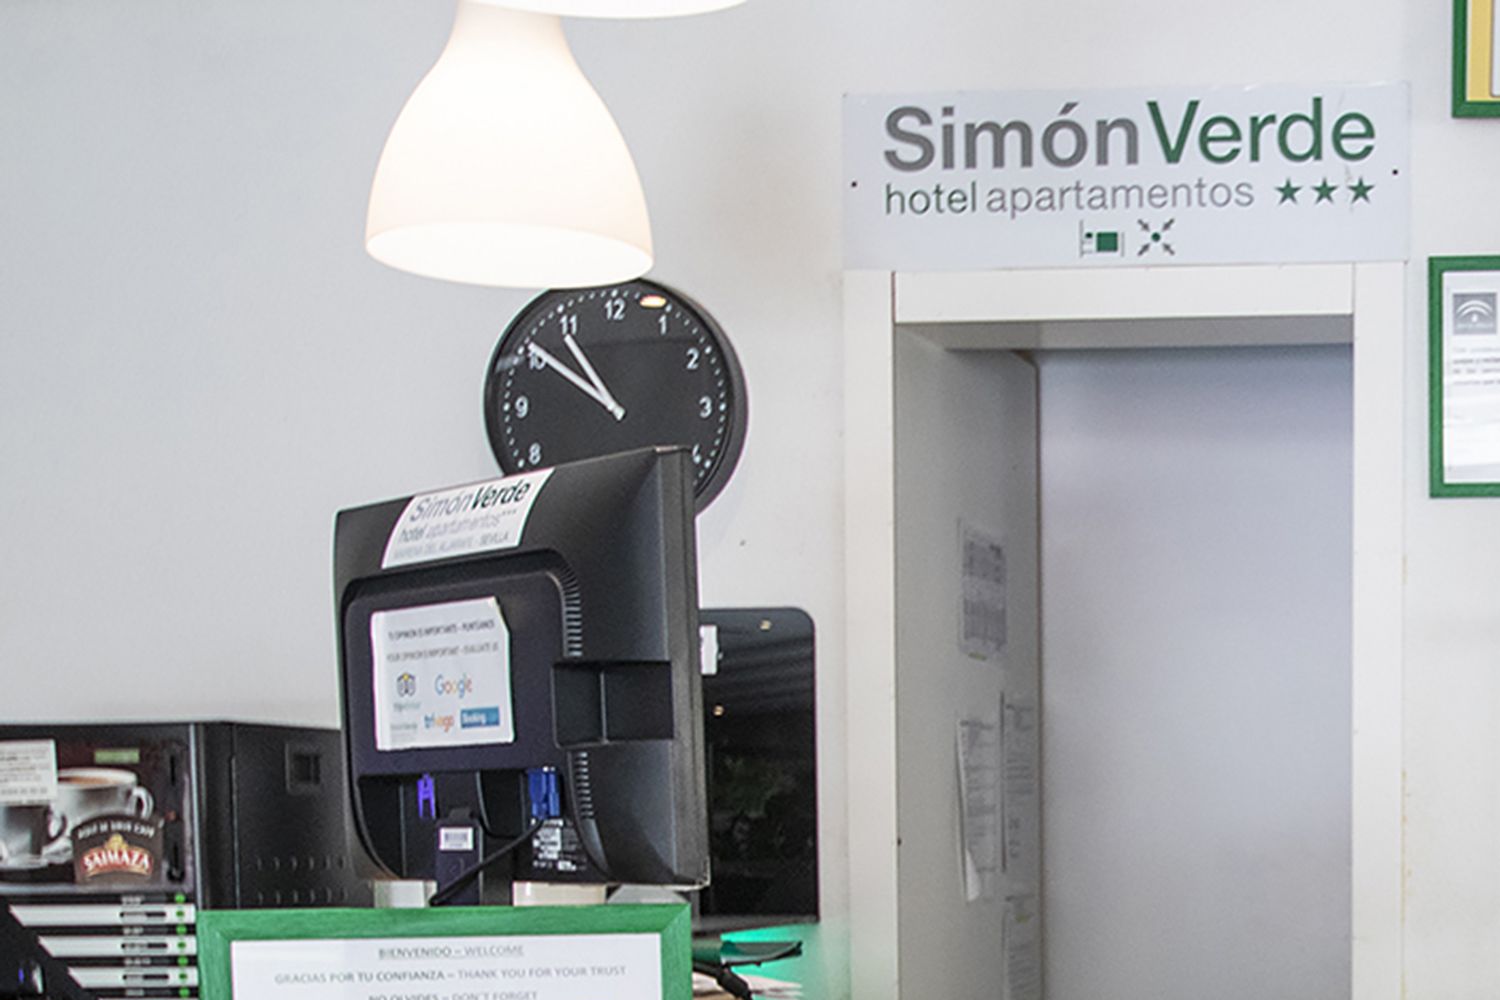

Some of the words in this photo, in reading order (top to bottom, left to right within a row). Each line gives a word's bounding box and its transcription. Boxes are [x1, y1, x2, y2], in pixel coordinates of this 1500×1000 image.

[884, 97, 1376, 172] SimónVerde
[885, 180, 977, 214] hotel
[986, 177, 1254, 219] apartamentos
[605, 300, 625, 320] 12
[560, 315, 577, 335] 11
[658, 314, 667, 335] 1
[687, 348, 699, 370] 2
[515, 396, 528, 418] 9
[699, 396, 712, 419] 3
[529, 443, 541, 464] 8
[435, 673, 472, 698] Google
[379, 946, 451, 960] BIENVENIDO
[464, 944, 524, 957] WELCOME
[275, 972, 326, 984] GRACIAS
[330, 972, 354, 982] POR
[357, 971, 373, 982] TU
[376, 970, 445, 981] CONFIANZA
[458, 969, 497, 979] THANK
[501, 968, 526, 978] YOU
[529, 967, 551, 977] FOR
[552, 966, 587, 977] YOUR
[591, 965, 626, 976] TRUST
[493, 991, 538, 1000] FORGET
